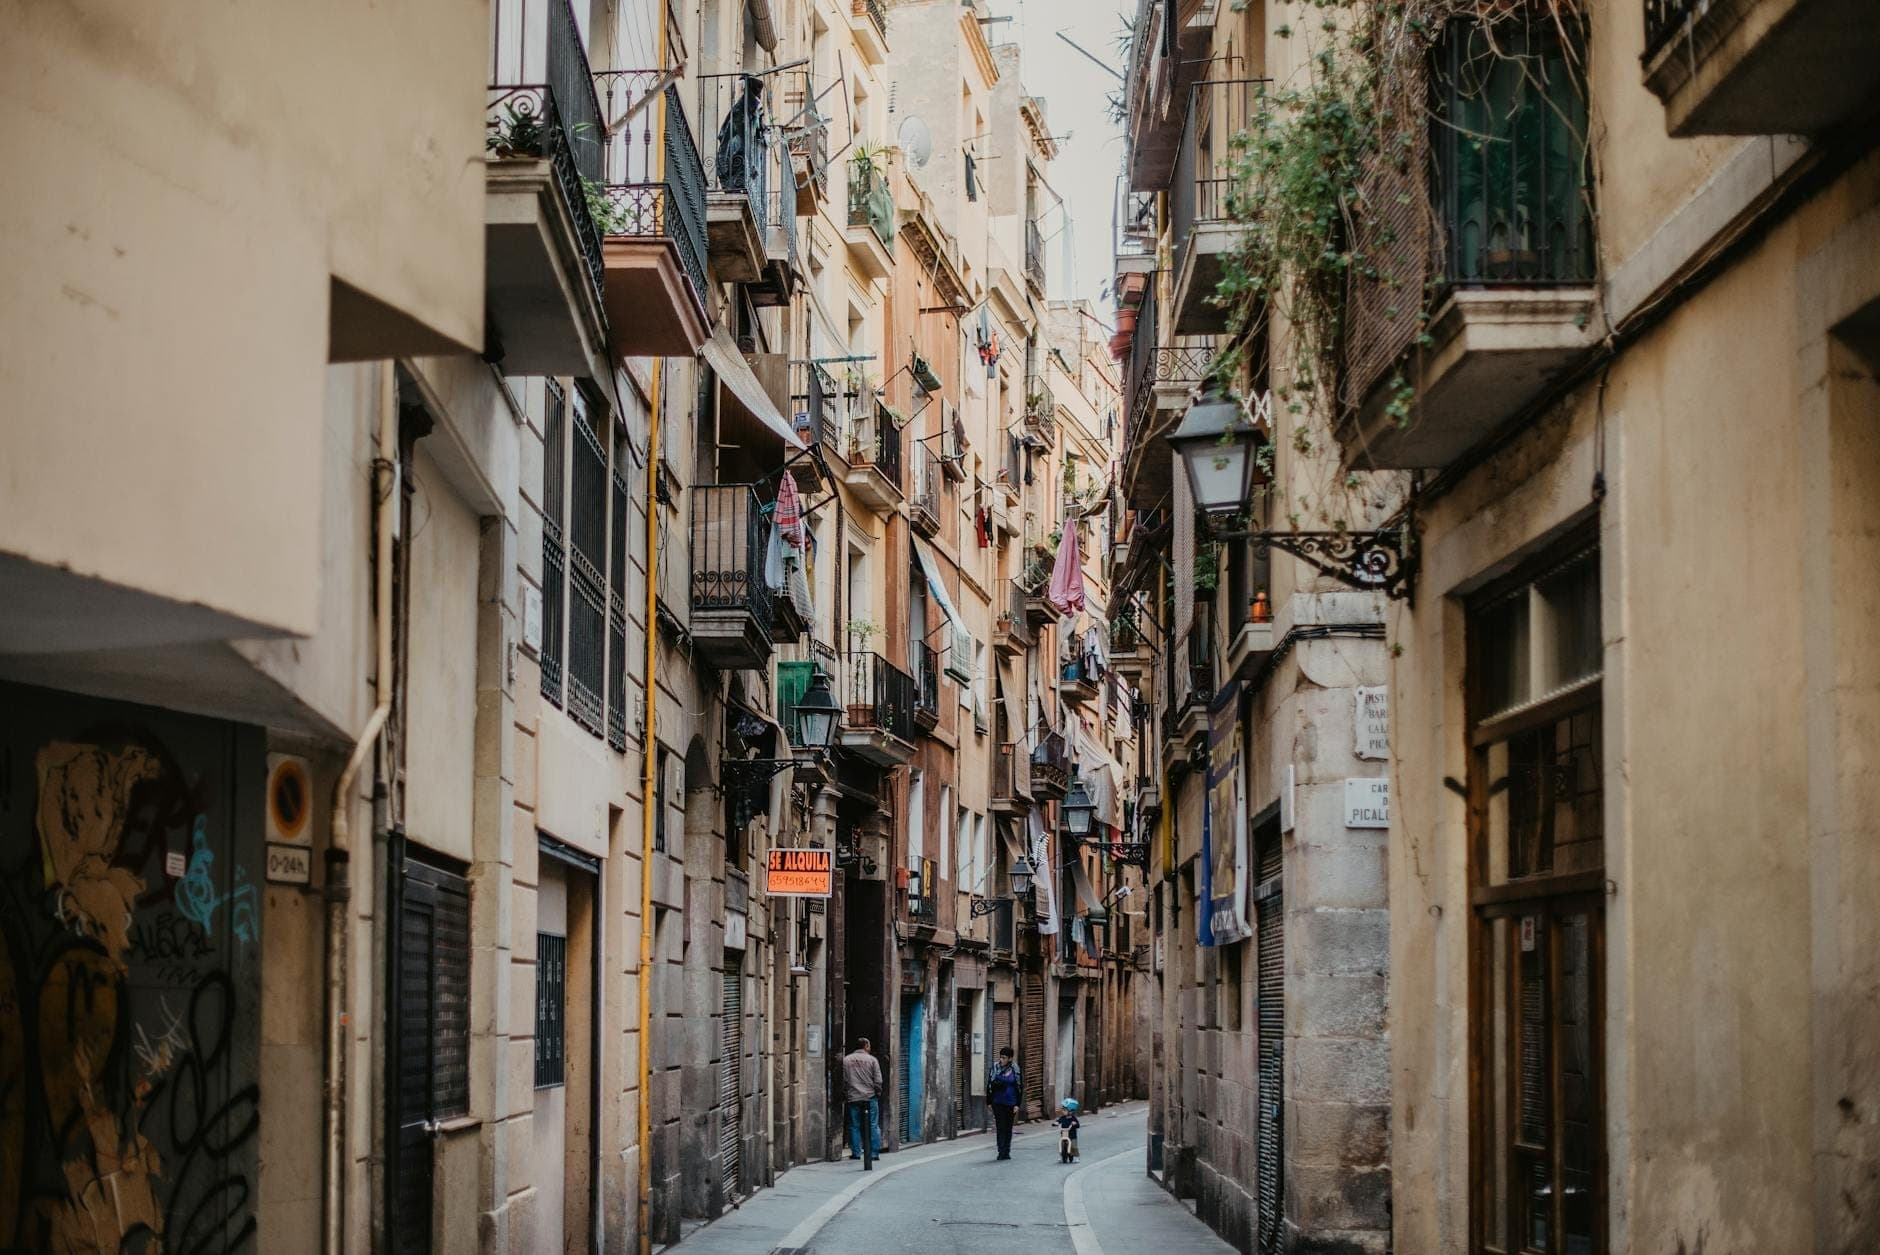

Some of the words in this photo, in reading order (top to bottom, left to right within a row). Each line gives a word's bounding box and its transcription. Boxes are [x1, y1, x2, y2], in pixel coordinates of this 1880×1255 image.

[1368, 709, 1388, 719] BAR
[1371, 784, 1388, 793] CAR
[769, 851, 782, 870] SE
[784, 851, 829, 871] ALQUILA
